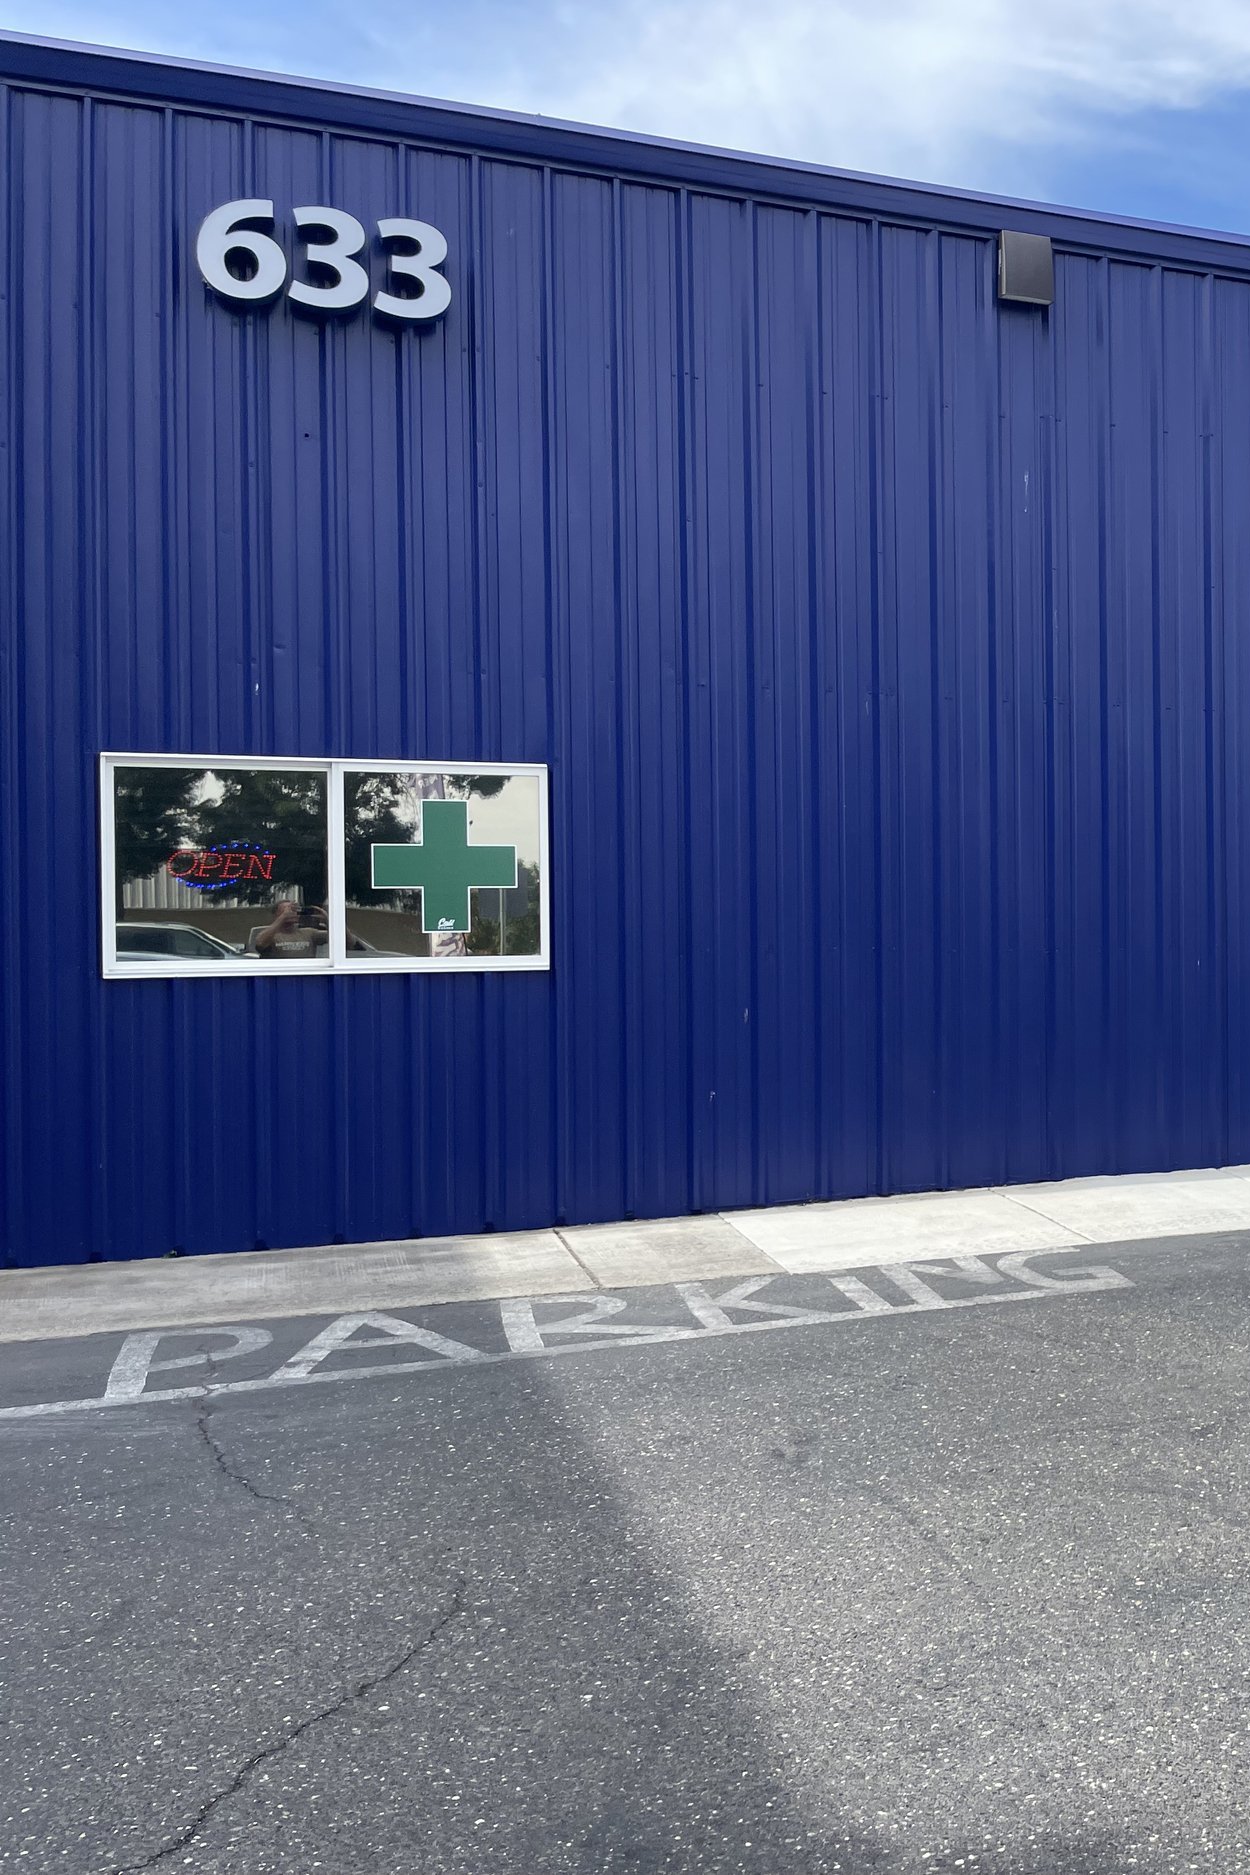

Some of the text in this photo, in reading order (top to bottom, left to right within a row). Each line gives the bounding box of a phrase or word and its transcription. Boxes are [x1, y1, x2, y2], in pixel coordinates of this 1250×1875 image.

[197, 198, 452, 319] 633
[166, 850, 277, 879] OPEN
[103, 1245, 1138, 1400] PARKING
